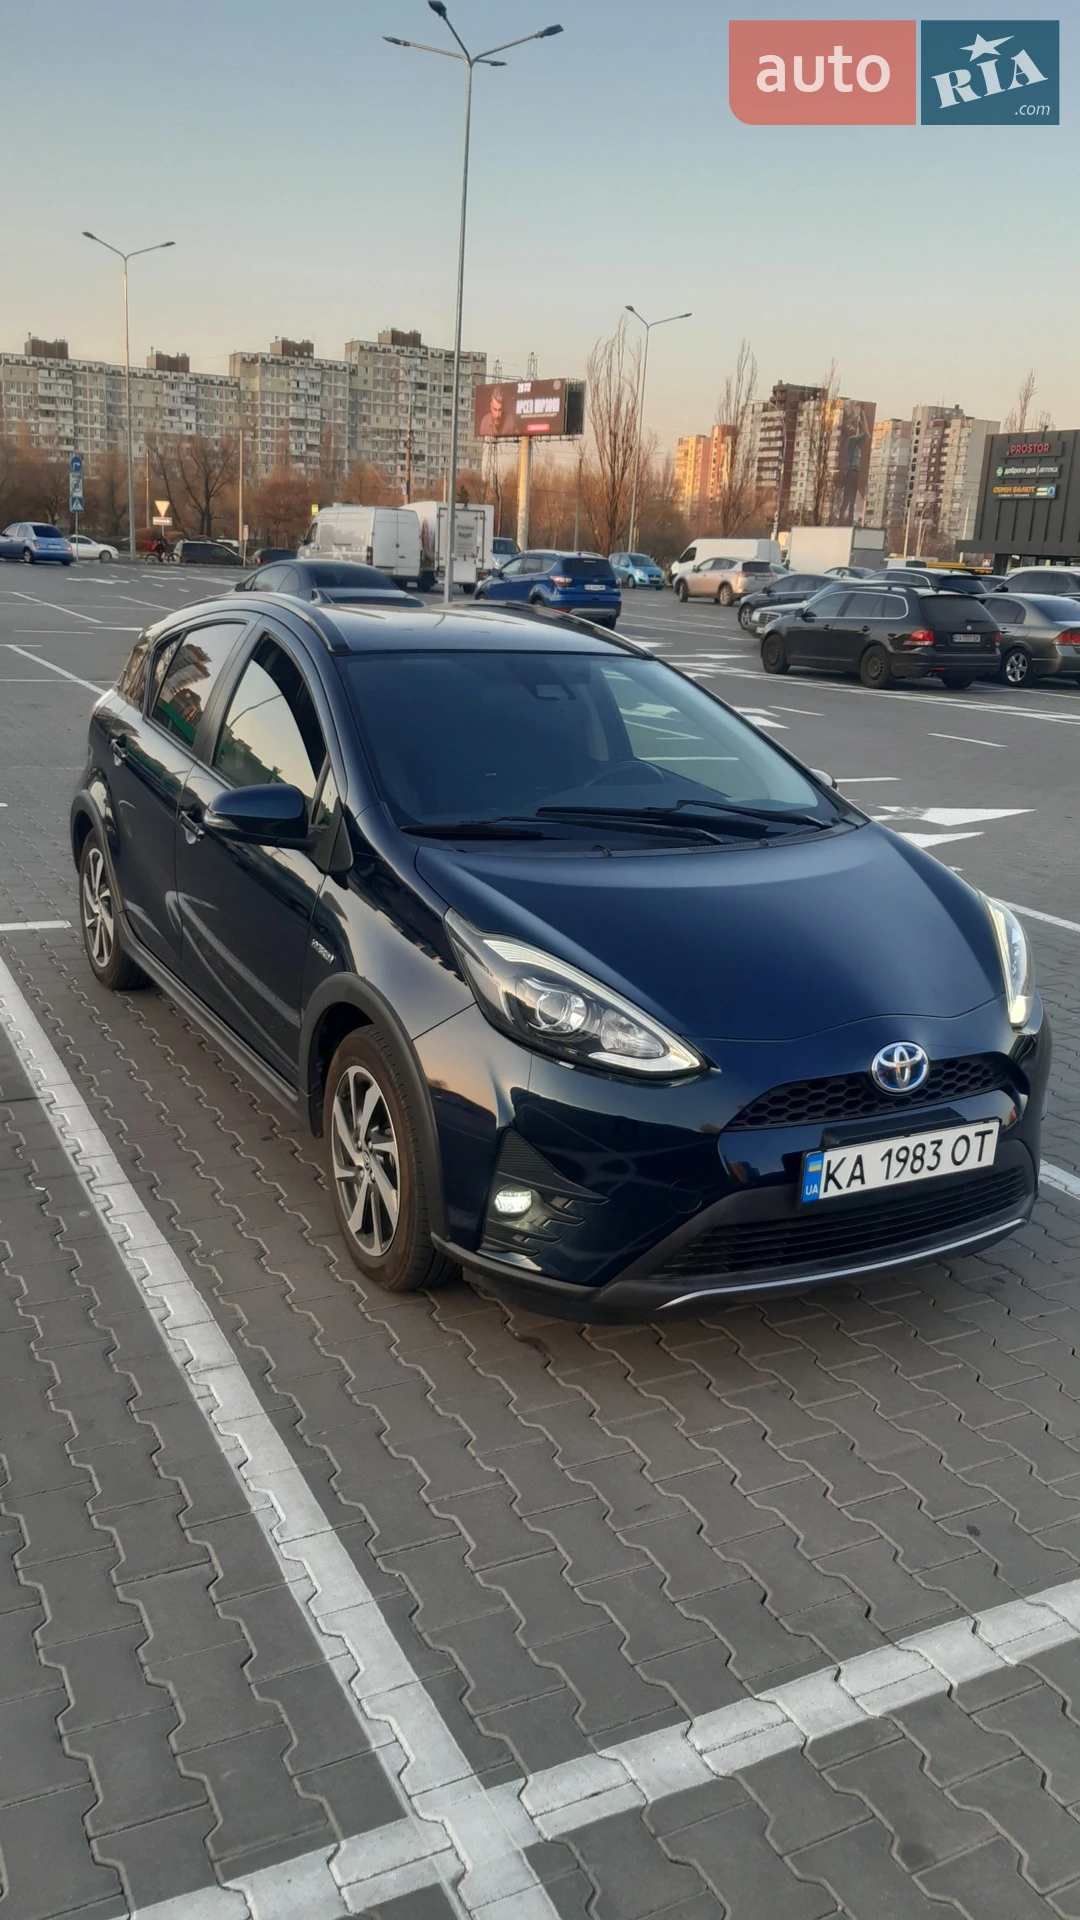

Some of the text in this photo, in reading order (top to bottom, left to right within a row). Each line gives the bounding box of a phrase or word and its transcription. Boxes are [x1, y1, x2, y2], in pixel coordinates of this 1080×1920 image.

[823, 1129, 994, 1193] KA 1983 OT
[805, 1184, 818, 1195] UA
